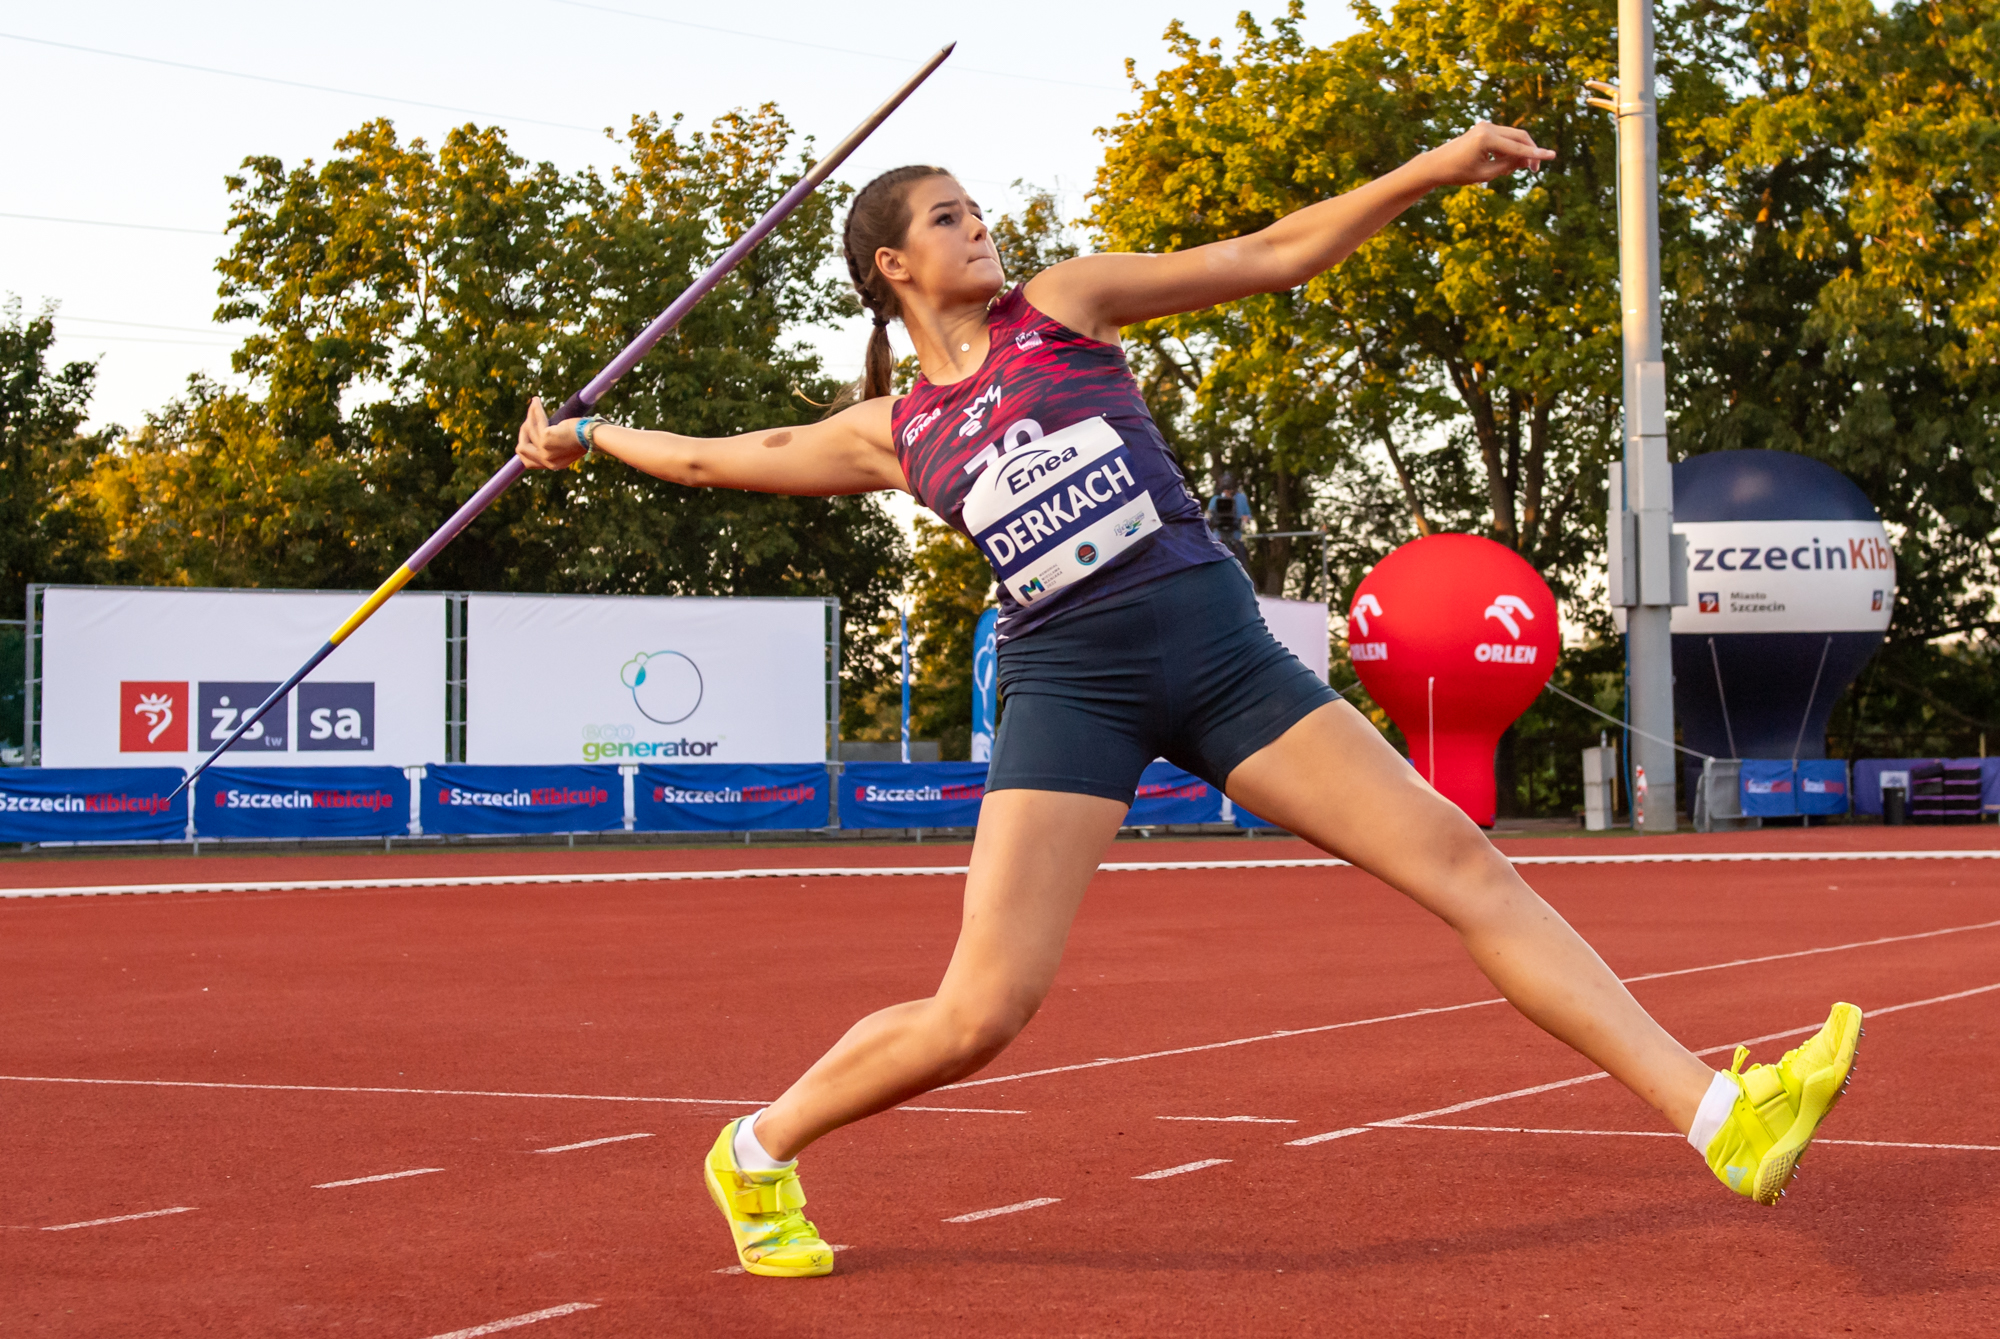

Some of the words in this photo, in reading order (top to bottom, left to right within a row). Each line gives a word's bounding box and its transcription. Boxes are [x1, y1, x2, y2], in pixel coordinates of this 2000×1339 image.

[906, 407, 941, 447] Enea
[1007, 445, 1079, 496] Enea
[985, 455, 1136, 567] DERKACH
[1686, 535, 1894, 572] zczecinKib
[1730, 591, 1767, 600] Miasto
[1730, 601, 1786, 613] Szczecin
[1474, 643, 1538, 665] ORLEN
[210, 695, 265, 740] żs
[264, 736, 283, 747] tw
[309, 708, 362, 740] sa
[360, 736, 368, 746] a
[582, 737, 718, 763] generator
[215, 789, 393, 813] #SzczecinKibicuje
[439, 787, 608, 808] #SzczecinKibicuje
[653, 784, 816, 806] #SzczecinKibicuje
[855, 783, 984, 801] #SzczecinKibic
[1135, 783, 1207, 801] Kibicuje
